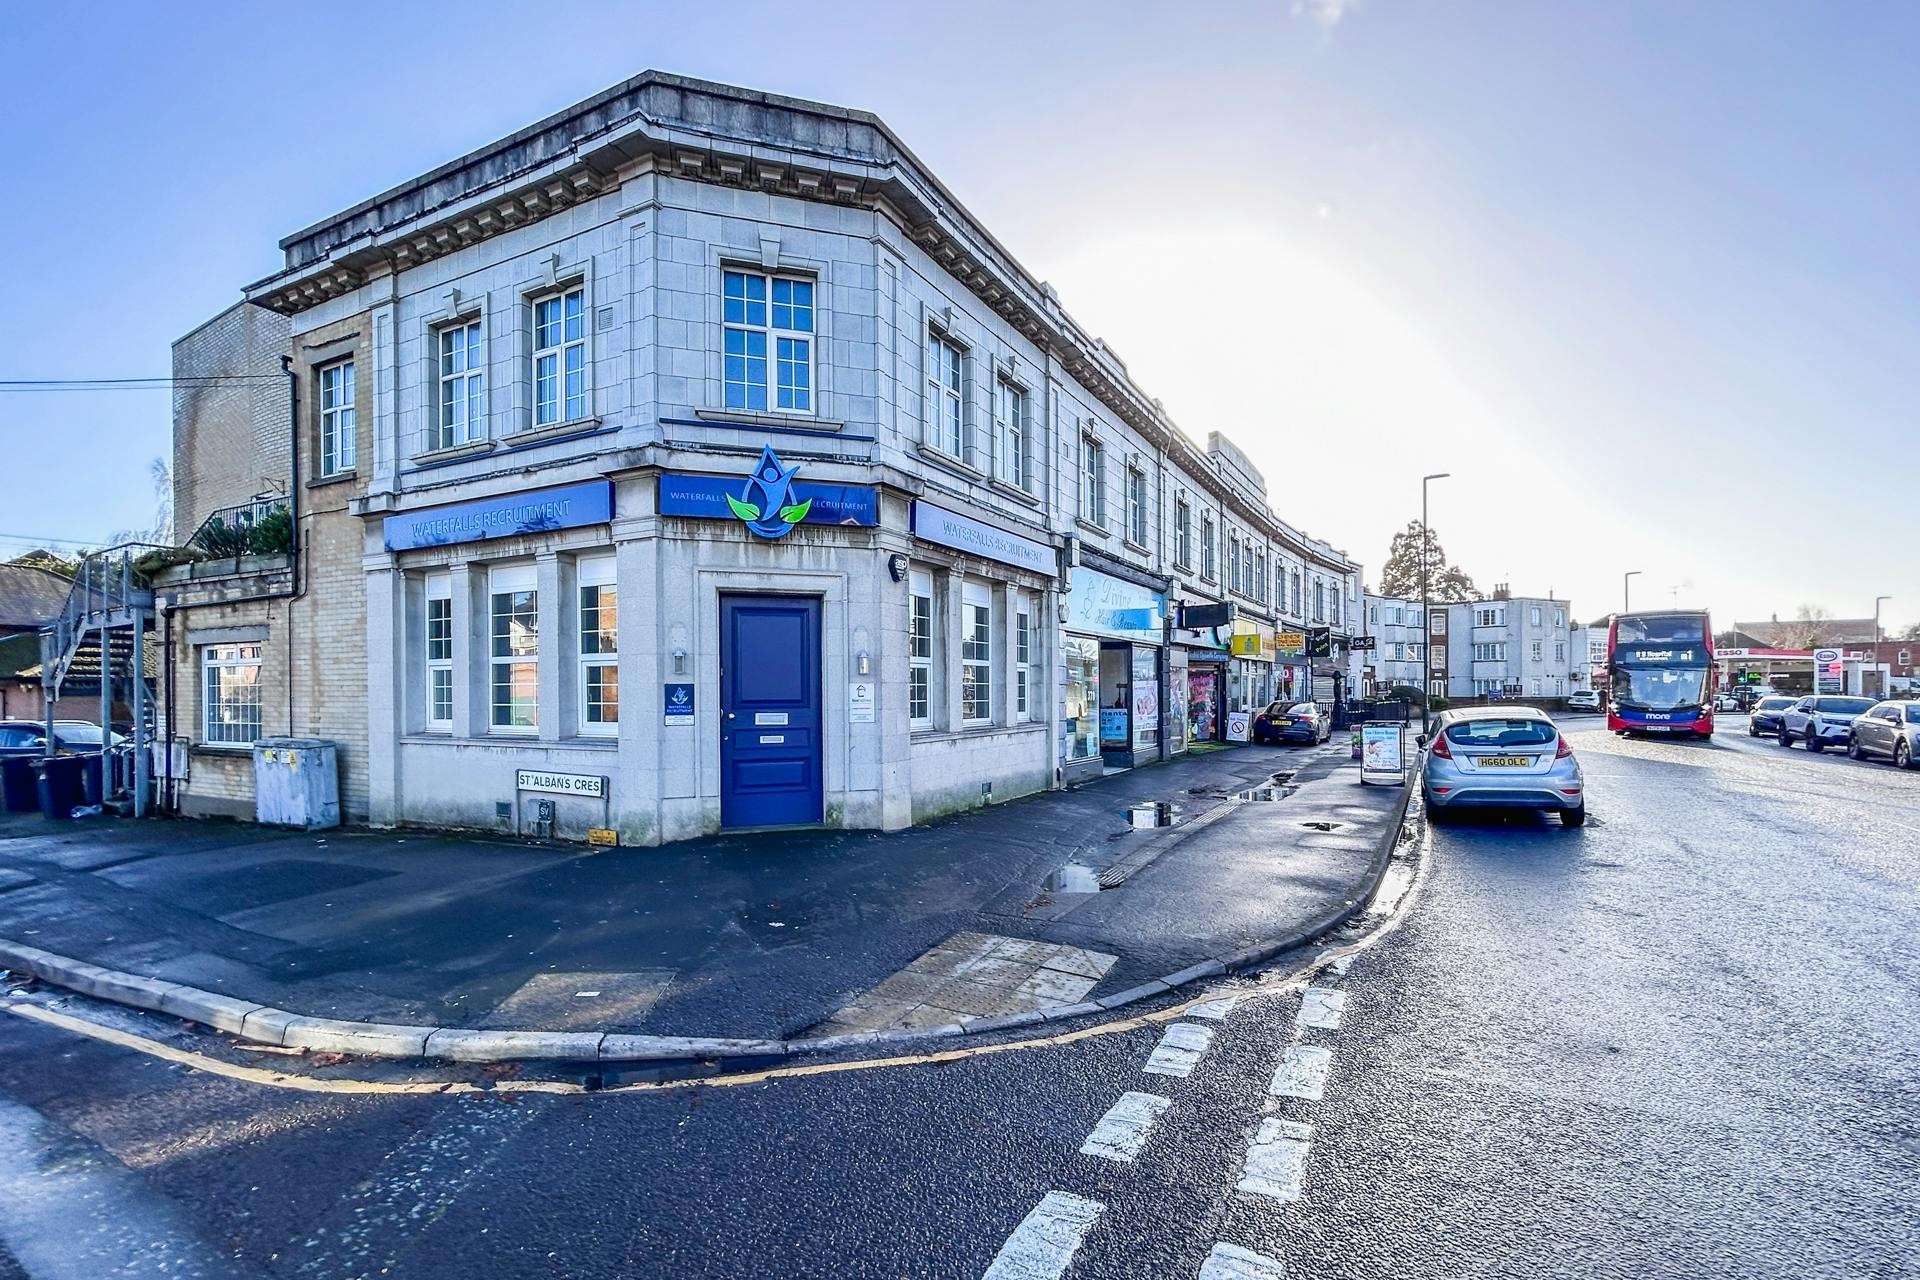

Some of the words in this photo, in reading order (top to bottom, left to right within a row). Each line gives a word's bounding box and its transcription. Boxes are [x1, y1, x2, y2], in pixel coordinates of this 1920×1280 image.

[670, 491, 727, 503] WATERFALLS
[812, 500, 868, 511] RECRUITMENT
[412, 513, 480, 538] WATERFALLS
[482, 499, 571, 528] RECRUITMENT
[942, 519, 994, 548] WATERFALLS
[994, 538, 1044, 564] RECRUITMENT
[1481, 758, 1506, 766] HG60
[519, 774, 531, 786] ST
[533, 775, 571, 789] ALBAN'S
[574, 779, 600, 792] CRES
